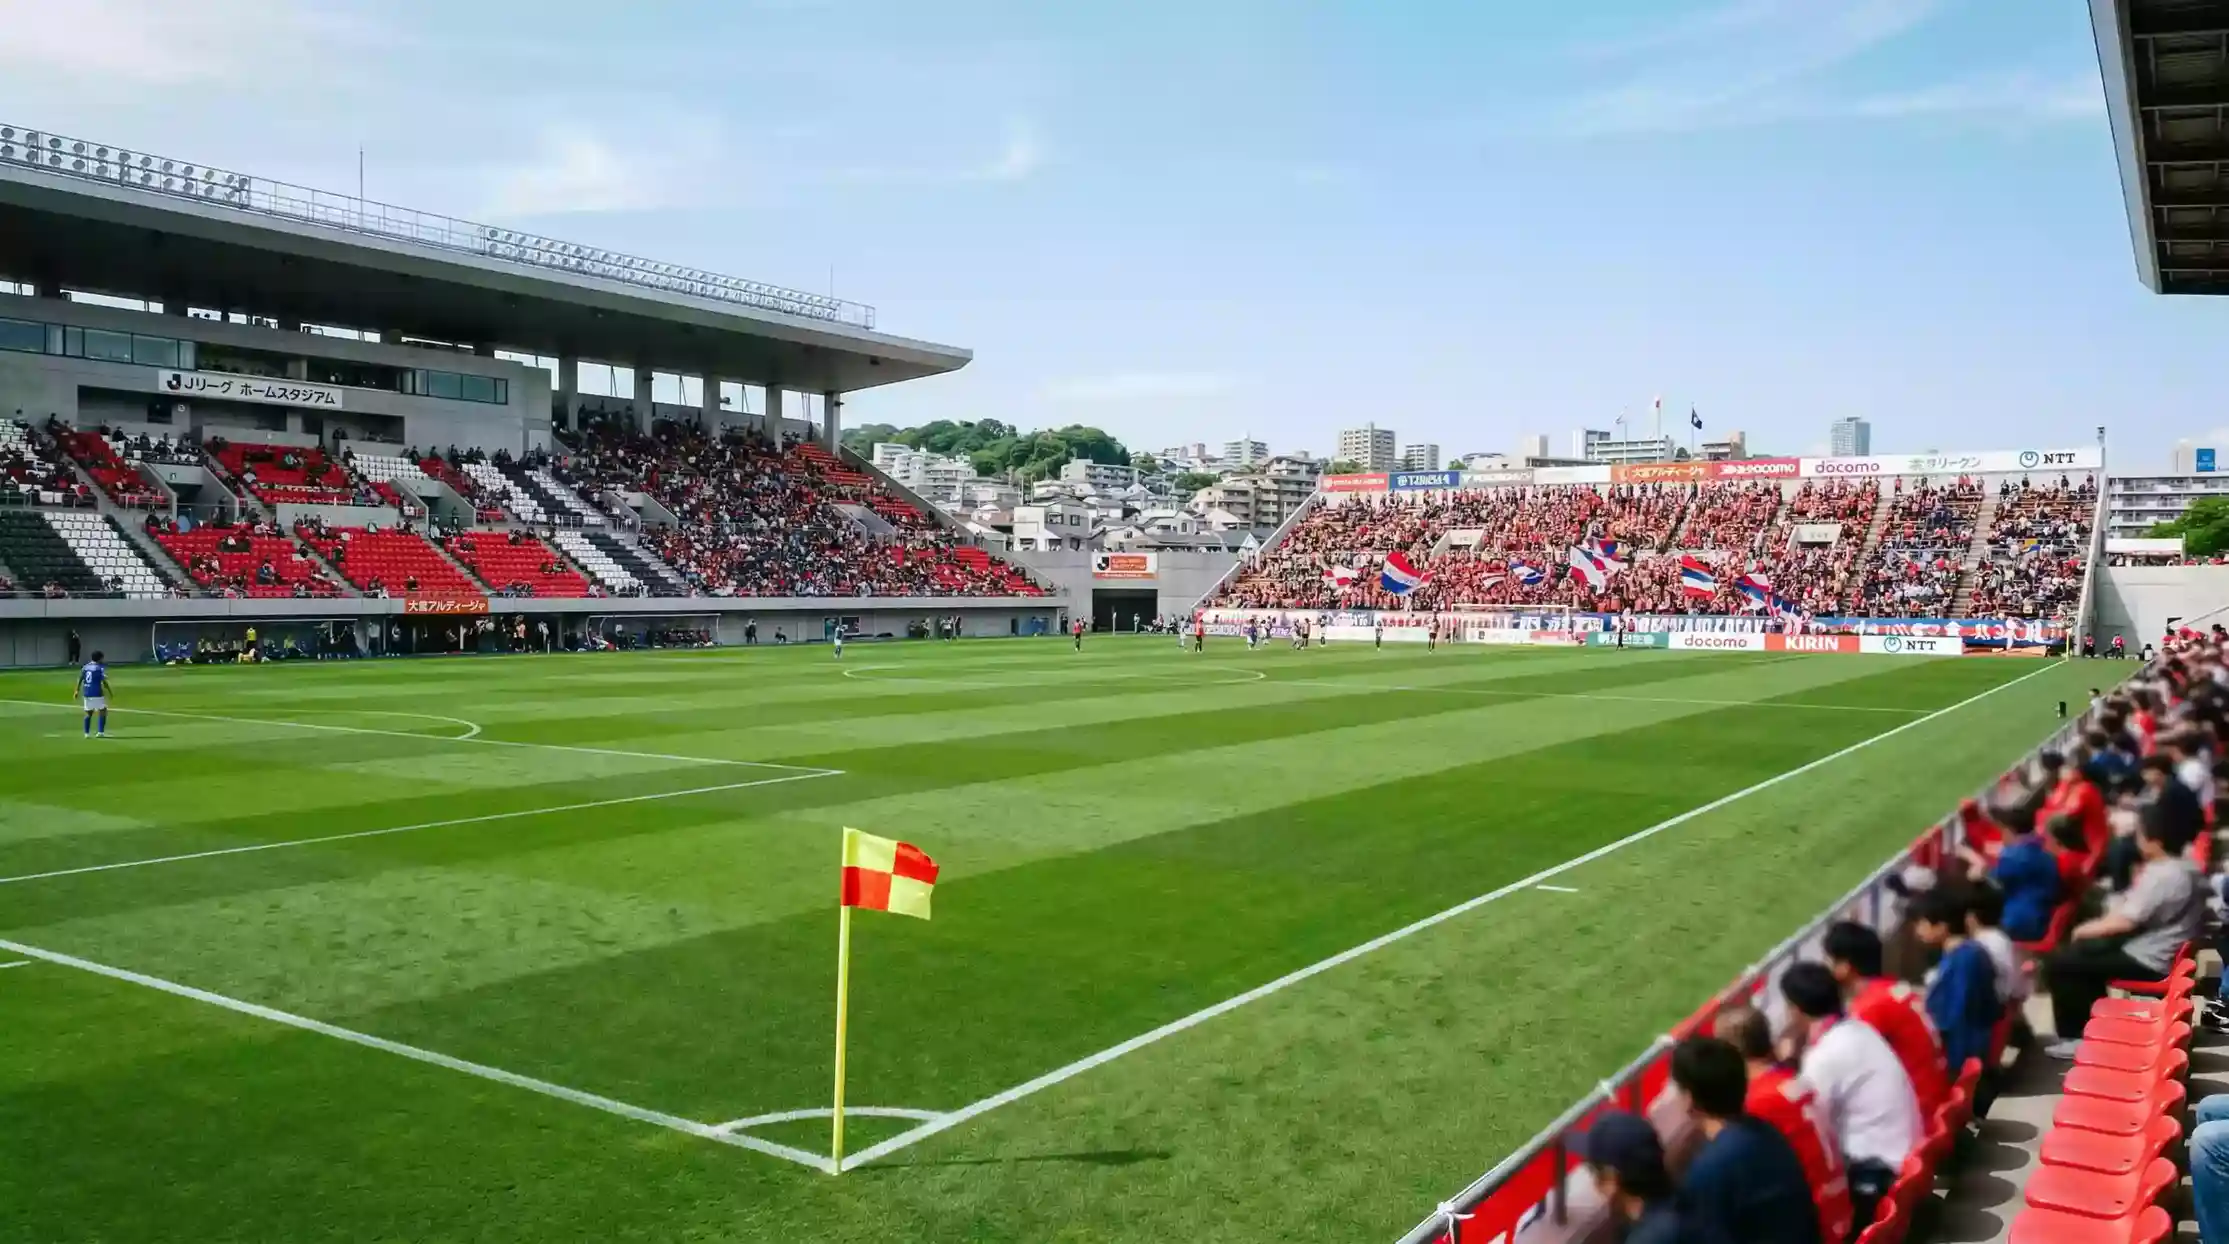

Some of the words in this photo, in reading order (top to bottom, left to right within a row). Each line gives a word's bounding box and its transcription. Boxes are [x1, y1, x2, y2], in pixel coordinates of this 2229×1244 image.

[184, 378, 233, 393] Jリーグ
[240, 383, 336, 404] ホームスタジアム
[2043, 453, 2076, 464] NTT
[1815, 460, 1880, 474] docomo
[1684, 635, 1748, 648] docomo
[1785, 636, 1839, 650] KIRIN
[1906, 640, 1937, 650] NTT
